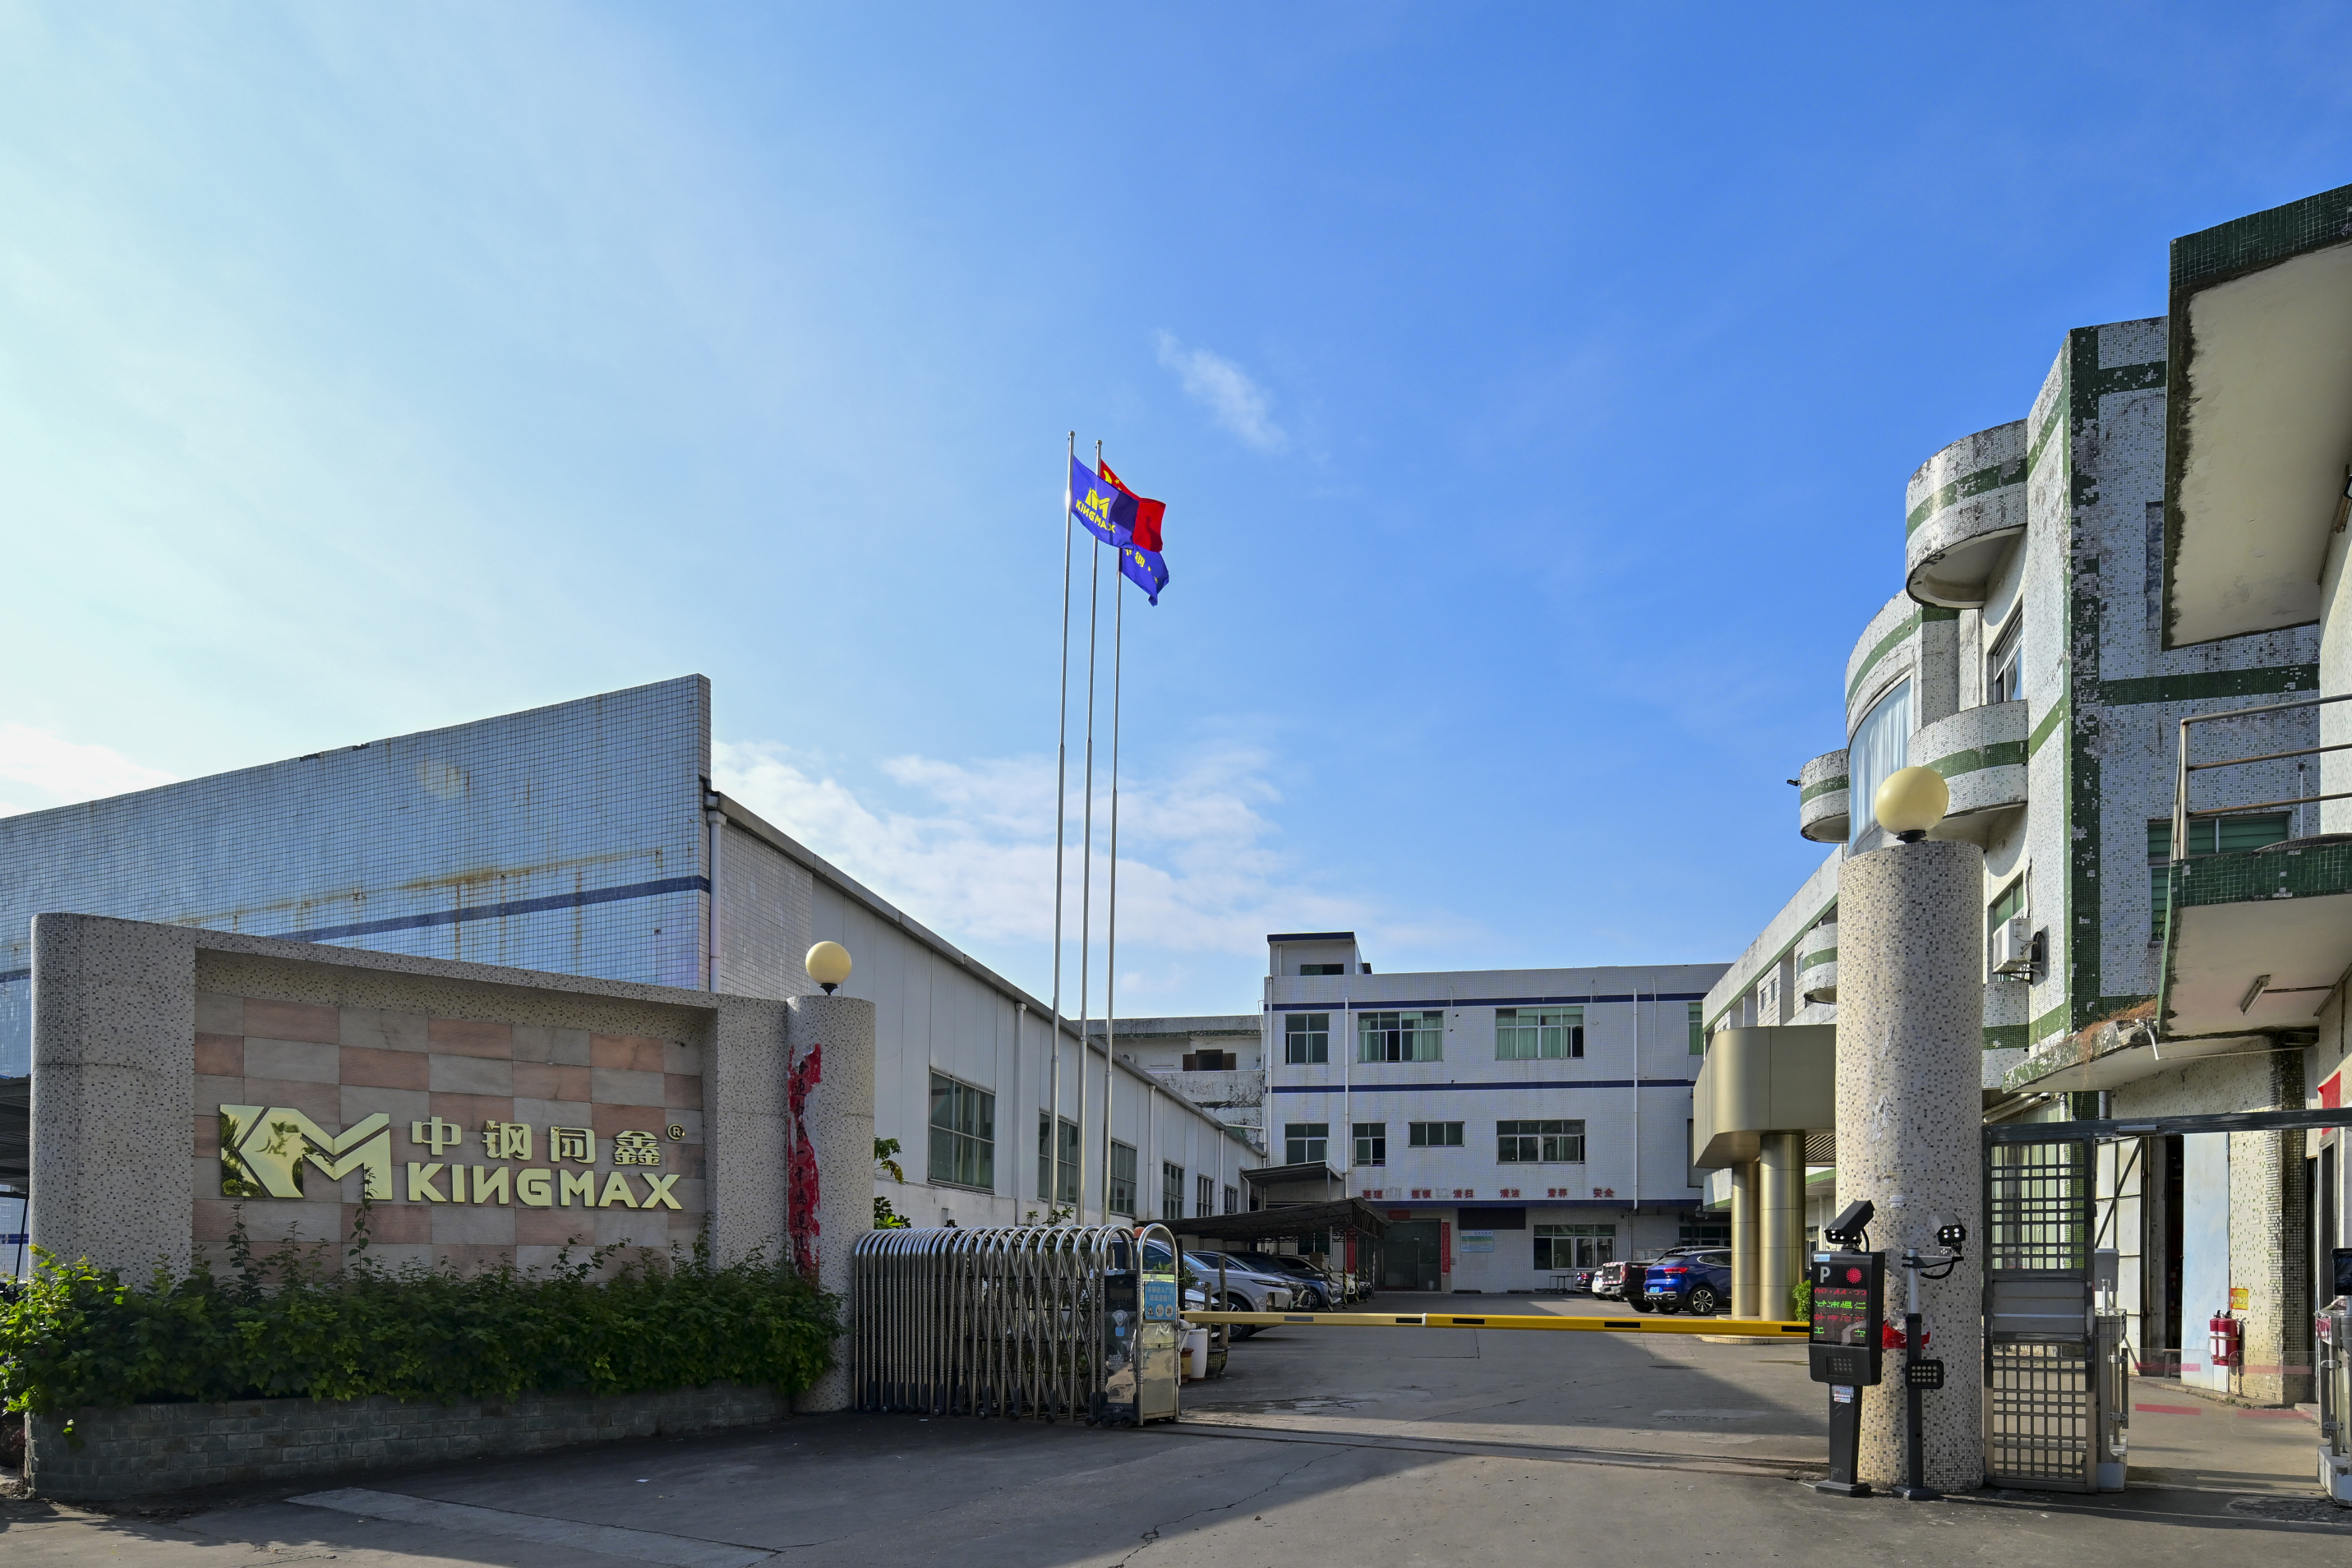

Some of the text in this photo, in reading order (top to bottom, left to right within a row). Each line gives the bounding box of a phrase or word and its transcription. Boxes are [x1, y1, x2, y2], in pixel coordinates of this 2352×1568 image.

[1076, 499, 1116, 533] KINGMAX
[412, 1116, 660, 1166] 中钢同鑫
[408, 1161, 683, 1210] KINGMAX
[1453, 1189, 1473, 1198] 清扫
[1500, 1188, 1520, 1198] 清洁
[1593, 1188, 1614, 1197] 安全
[1819, 1266, 1831, 1284] P
